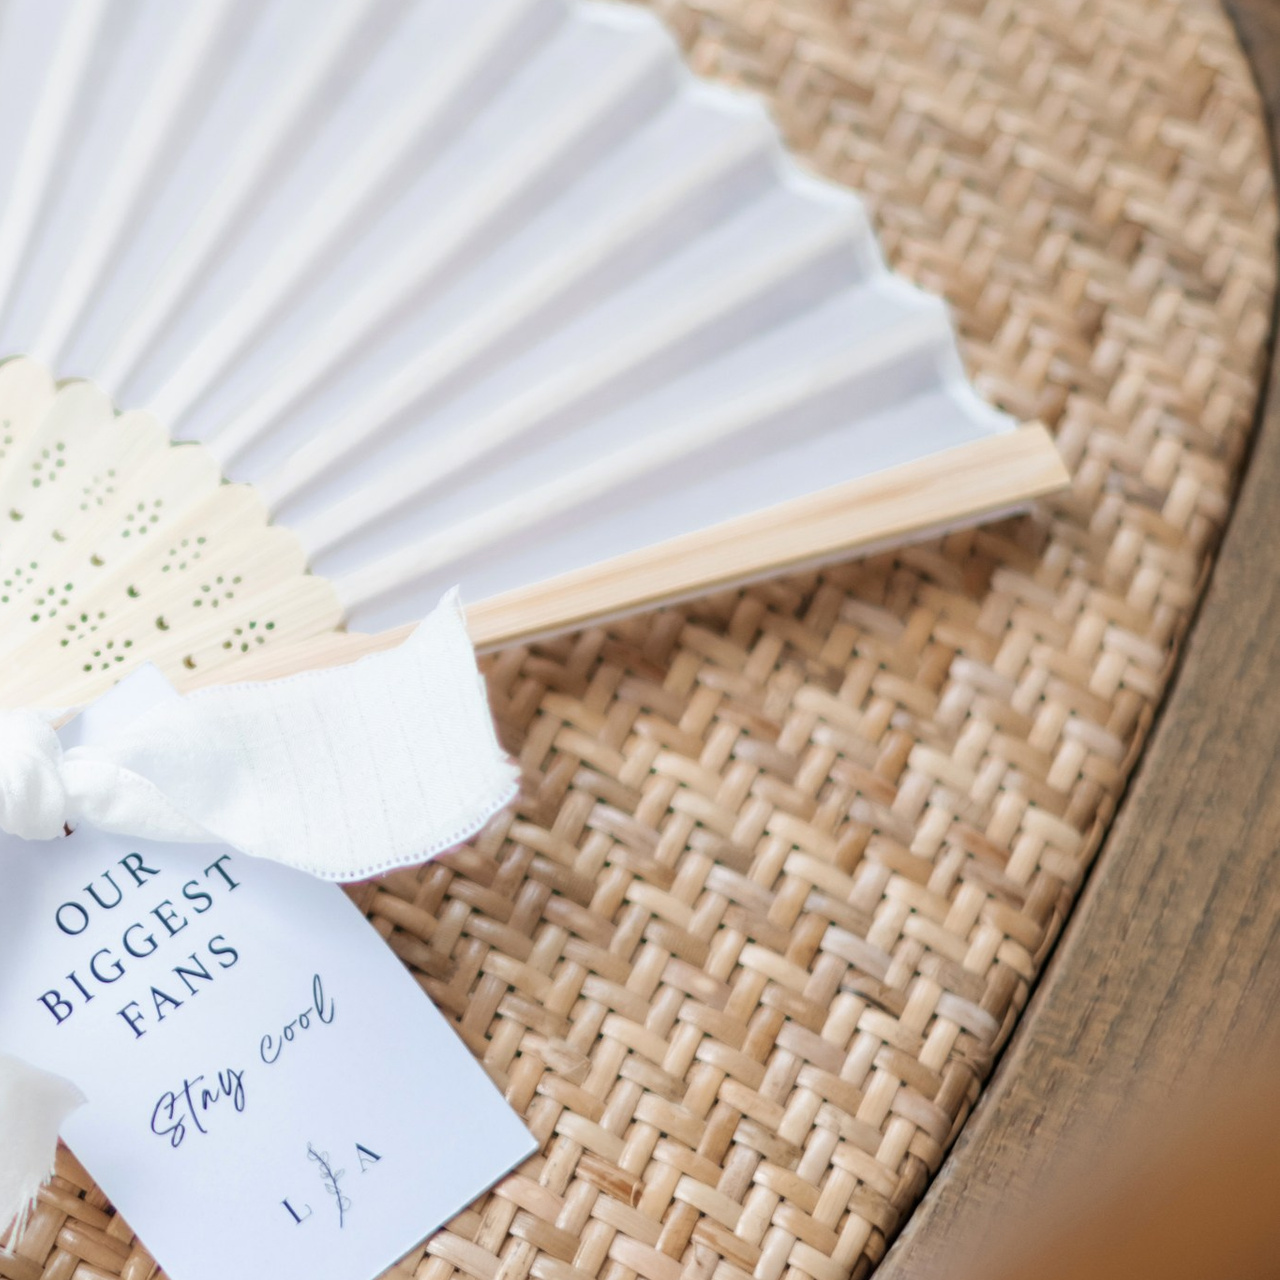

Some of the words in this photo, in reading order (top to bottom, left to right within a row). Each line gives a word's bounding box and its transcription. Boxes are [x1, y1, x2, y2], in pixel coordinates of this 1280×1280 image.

[37, 854, 241, 1025] BIGGEST
[55, 851, 161, 936] OUR
[117, 934, 240, 1039] FANS
[150, 1068, 245, 1148] Stay
[260, 973, 335, 1064] cool
[280, 1197, 313, 1225] L
[355, 1142, 382, 1173] A
